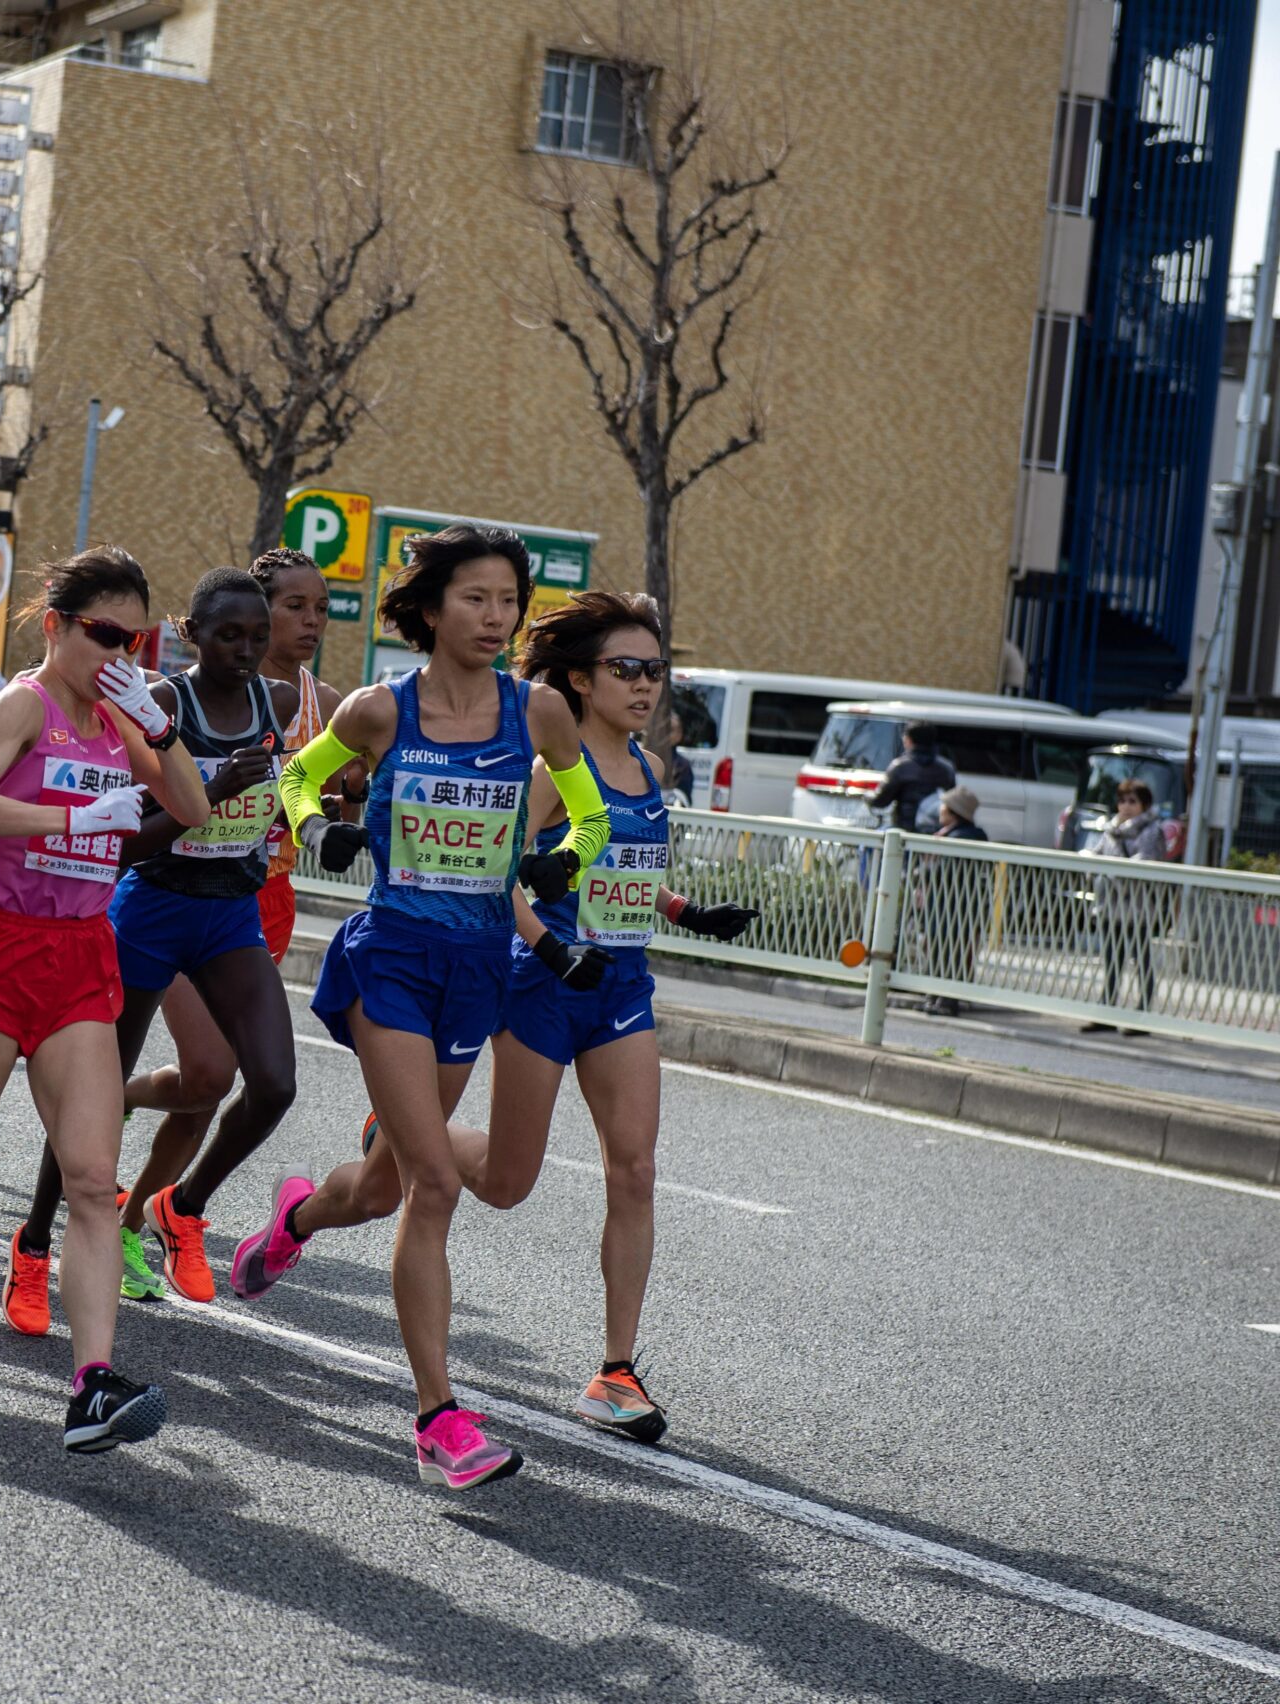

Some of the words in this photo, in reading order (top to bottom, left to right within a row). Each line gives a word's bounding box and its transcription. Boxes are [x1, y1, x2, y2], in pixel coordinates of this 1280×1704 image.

[301, 506, 340, 560] P
[401, 750, 449, 765] SEKISUI
[431, 780, 517, 809] 奥村組
[211, 796, 257, 820] ACE
[262, 793, 275, 816] 3
[611, 805, 635, 816] TOYOTA
[200, 826, 213, 836] 27
[401, 814, 485, 849] PACE
[492, 823, 508, 849] 4
[417, 852, 432, 863] 28
[439, 853, 487, 869] 新谷仁美
[618, 847, 667, 869] 奥村組
[588, 880, 652, 906] PACE
[602, 912, 616, 922] 29
